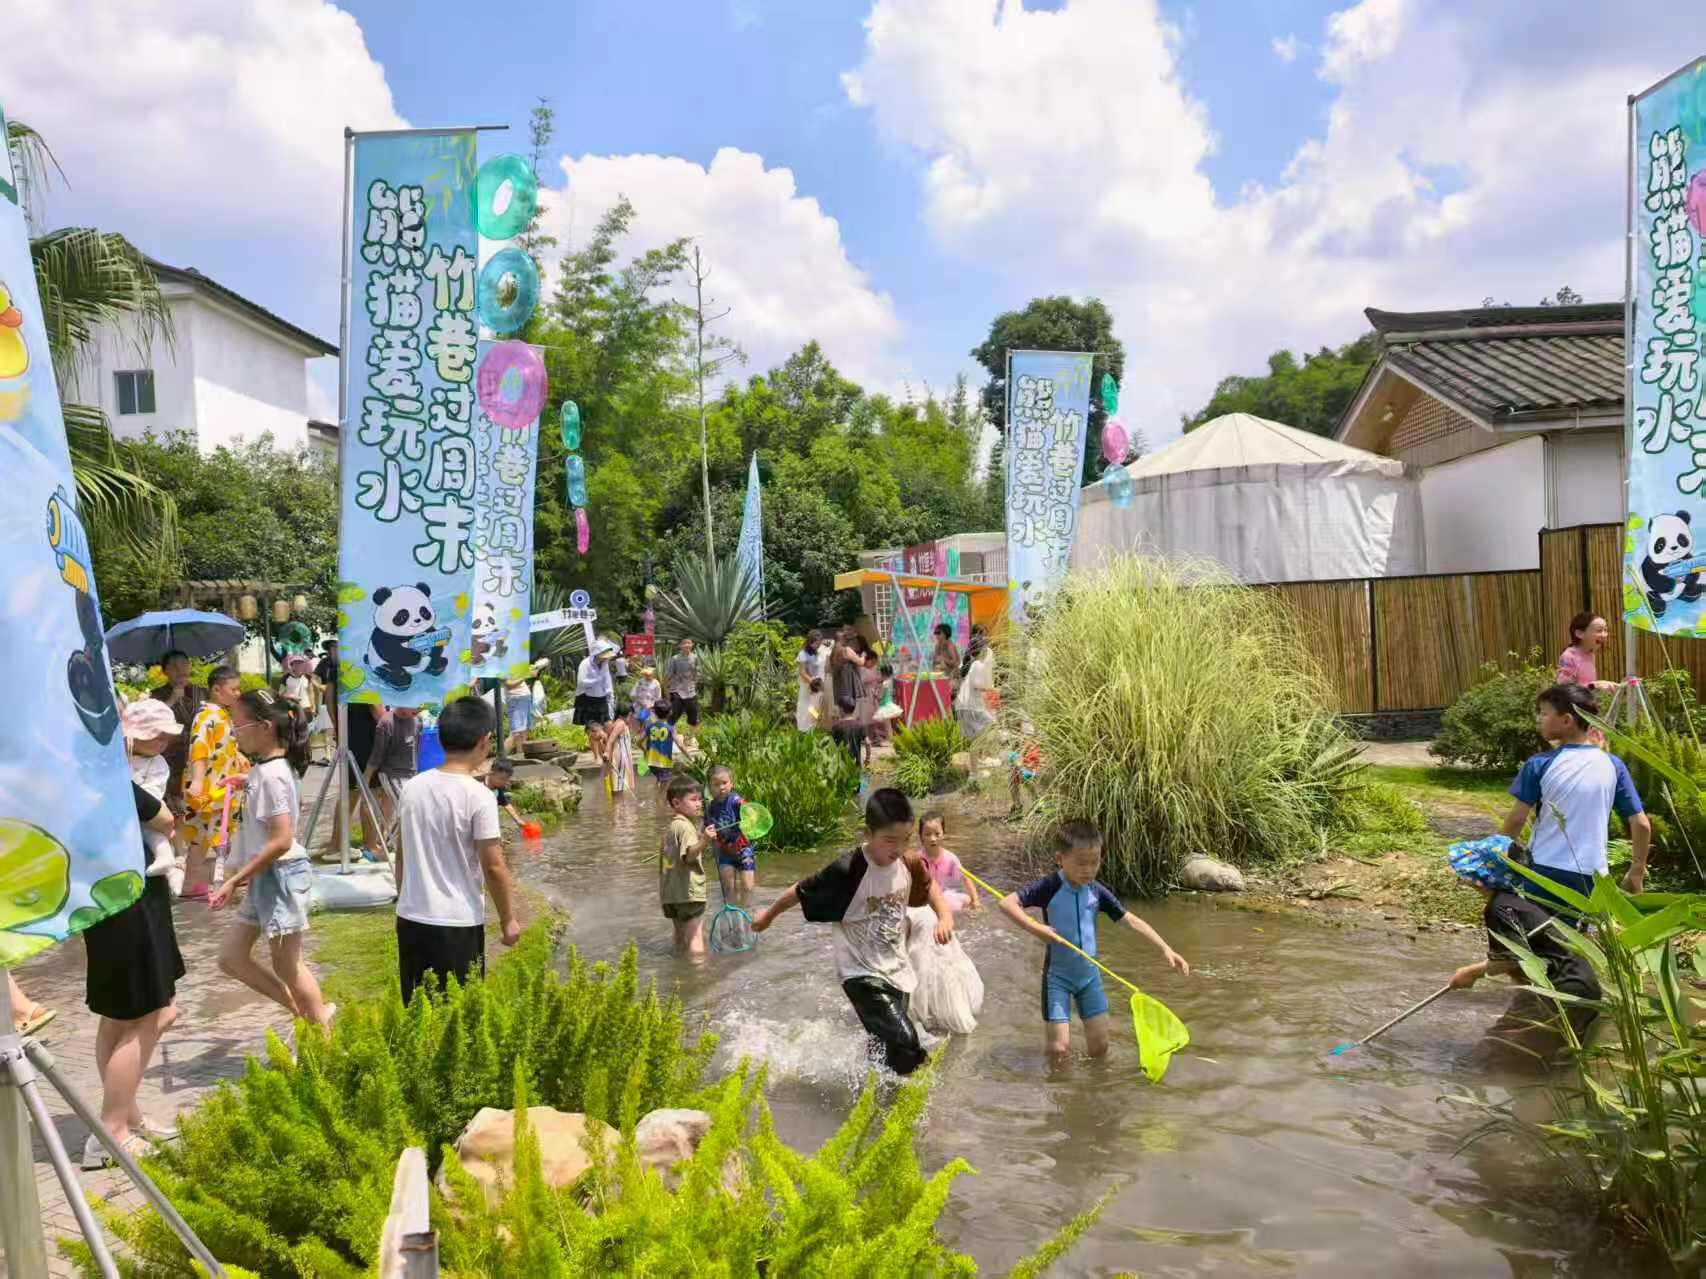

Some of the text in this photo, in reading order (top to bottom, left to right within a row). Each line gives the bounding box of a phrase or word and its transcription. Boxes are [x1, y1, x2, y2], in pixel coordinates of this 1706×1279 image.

[356, 179, 427, 522] 熊猫爱玩水
[413, 243, 477, 574] 竹巷过周末
[1636, 125, 1698, 453] 熊猫爱玩水
[1011, 374, 1056, 547] 熊猫爱玩水
